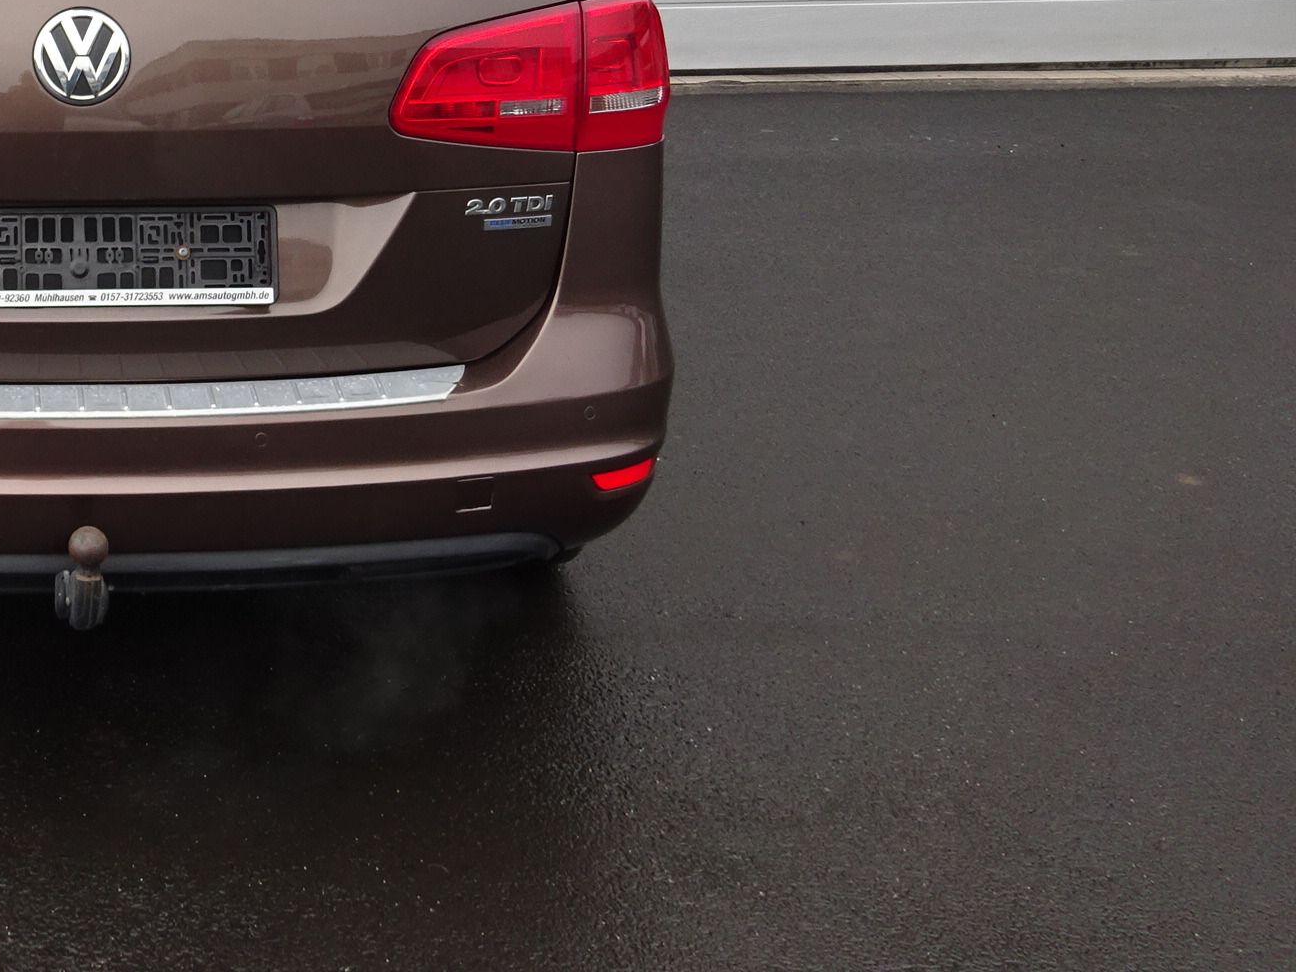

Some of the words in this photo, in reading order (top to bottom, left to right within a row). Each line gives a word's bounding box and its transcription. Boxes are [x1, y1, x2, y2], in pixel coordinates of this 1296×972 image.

[35, 8, 129, 104] VW
[464, 197, 506, 216] 2.0
[510, 194, 554, 213] TDI
[100, 292, 164, 302] 0157-31723553
[168, 290, 270, 302] www.amsautogmbh.de
